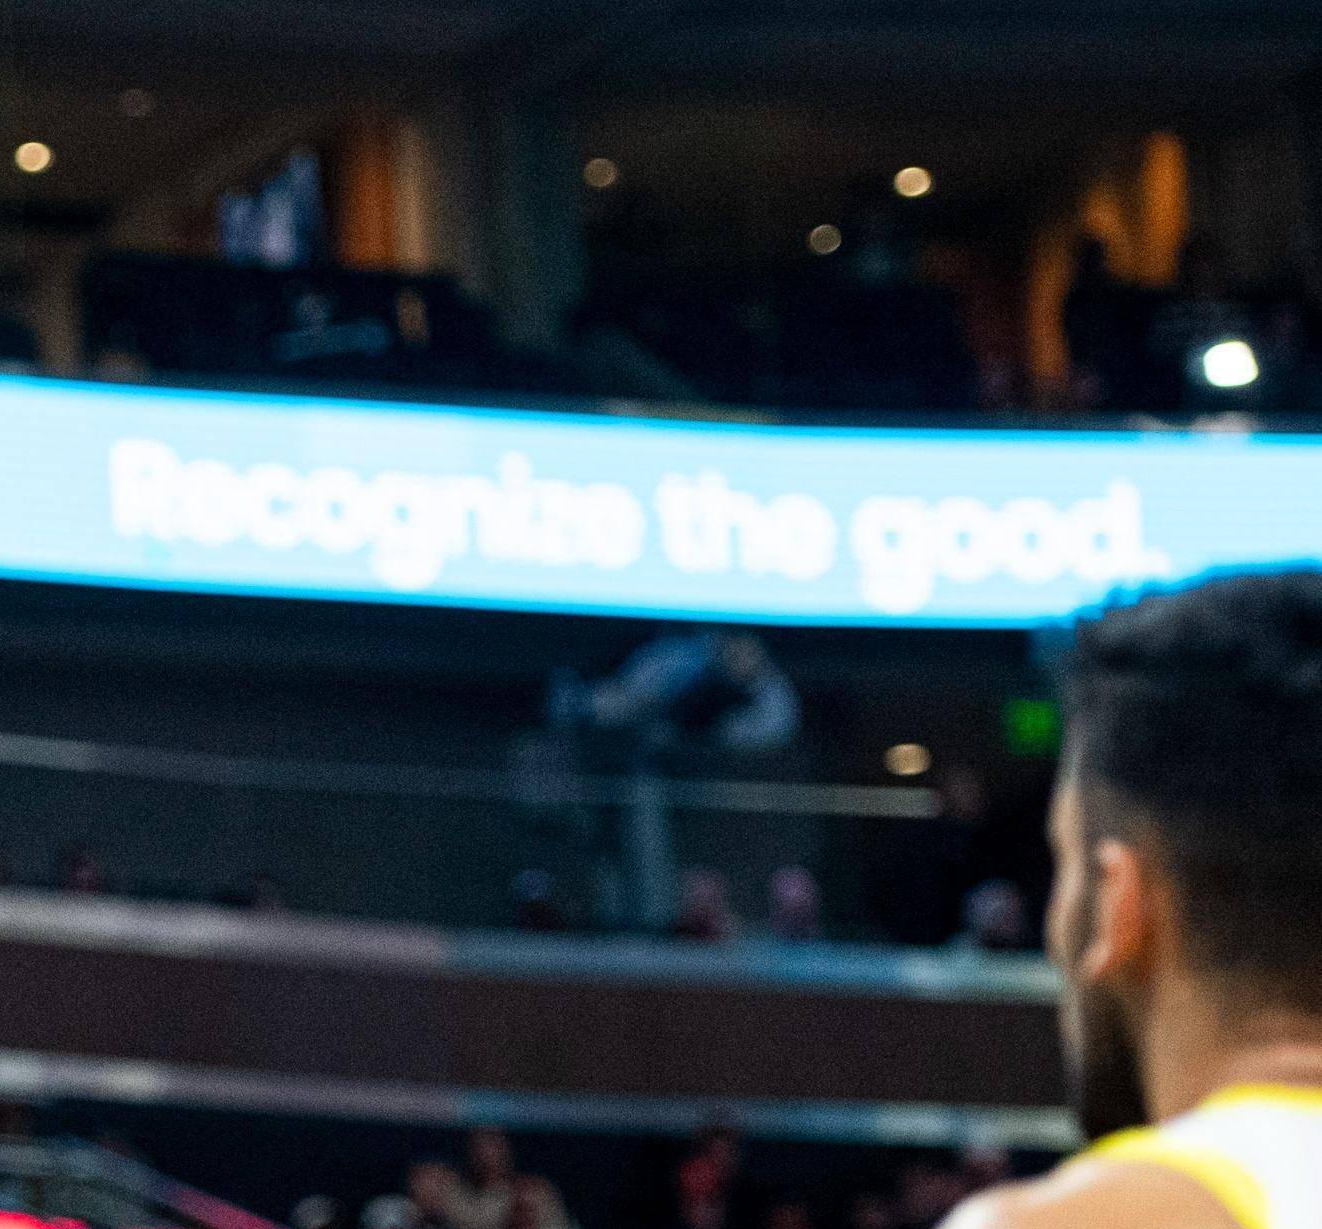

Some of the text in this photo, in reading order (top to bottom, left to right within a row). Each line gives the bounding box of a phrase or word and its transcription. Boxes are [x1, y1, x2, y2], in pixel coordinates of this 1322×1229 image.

[108, 437, 1172, 611] Recognize the good.
